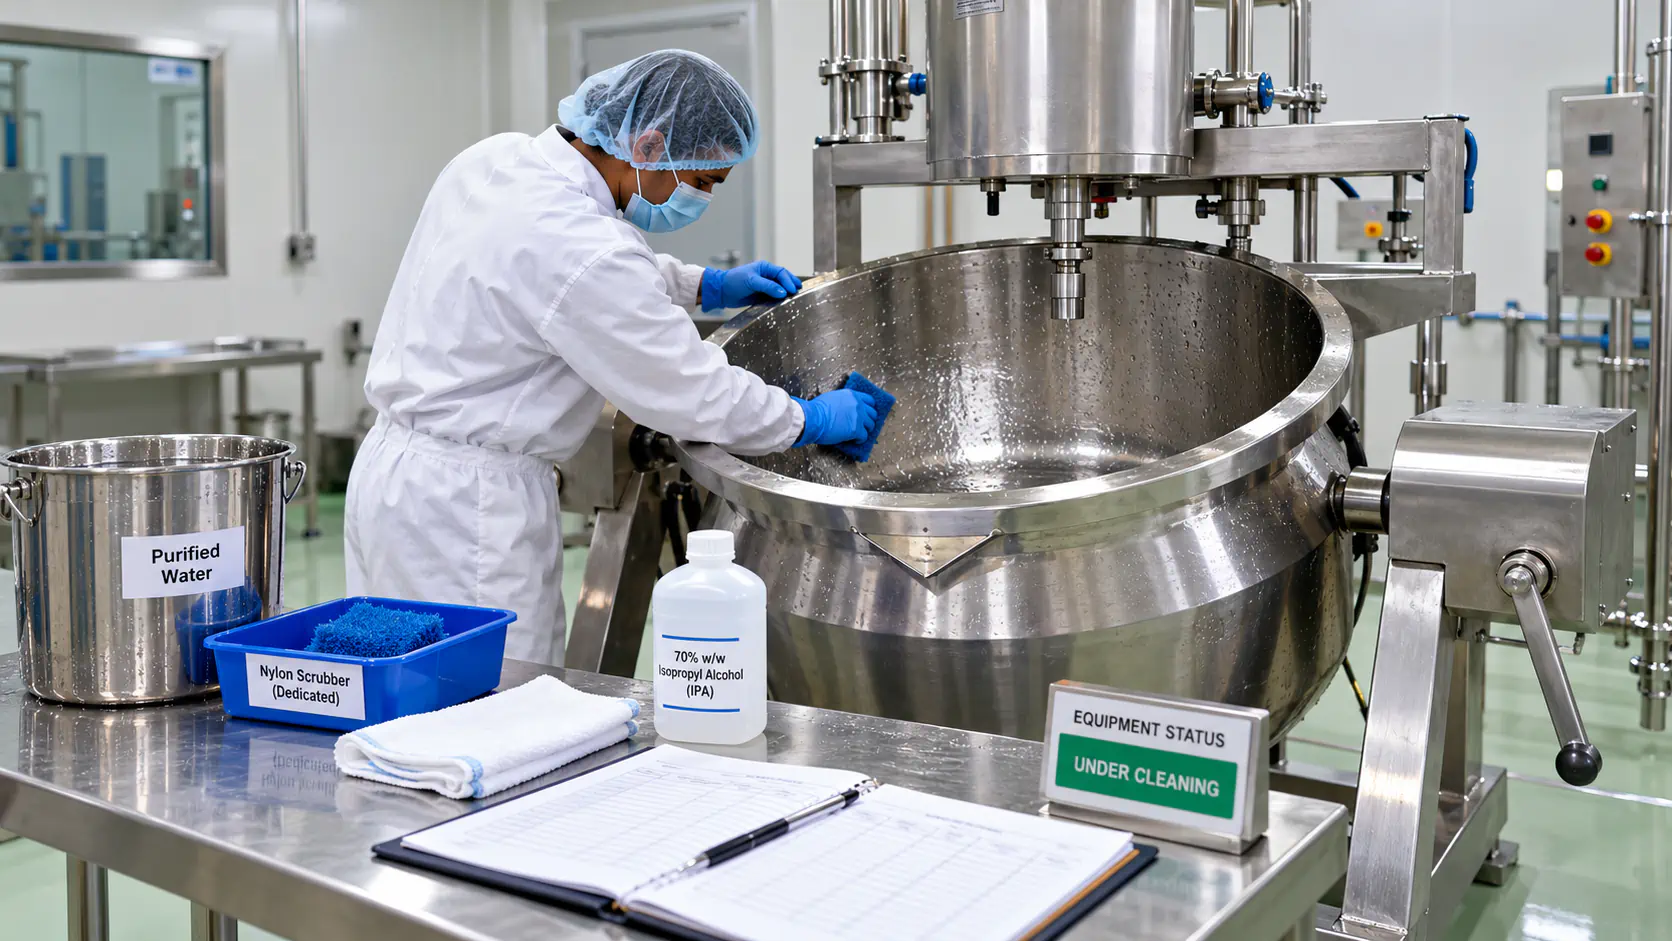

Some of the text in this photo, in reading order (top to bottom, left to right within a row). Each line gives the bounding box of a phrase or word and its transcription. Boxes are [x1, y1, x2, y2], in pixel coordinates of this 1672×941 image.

[152, 543, 220, 564] Purified
[161, 568, 213, 584] Water
[674, 651, 726, 665] 70% w/w
[259, 665, 351, 687] Nylon Scrubber
[659, 664, 744, 682] Isopropyl Alcohol
[272, 684, 340, 707] (Dedicated)
[686, 685, 714, 700] (IPA)
[1074, 709, 1226, 748] EQUIPMENT STATUS
[1074, 755, 1220, 797] UNDER CLEANING
